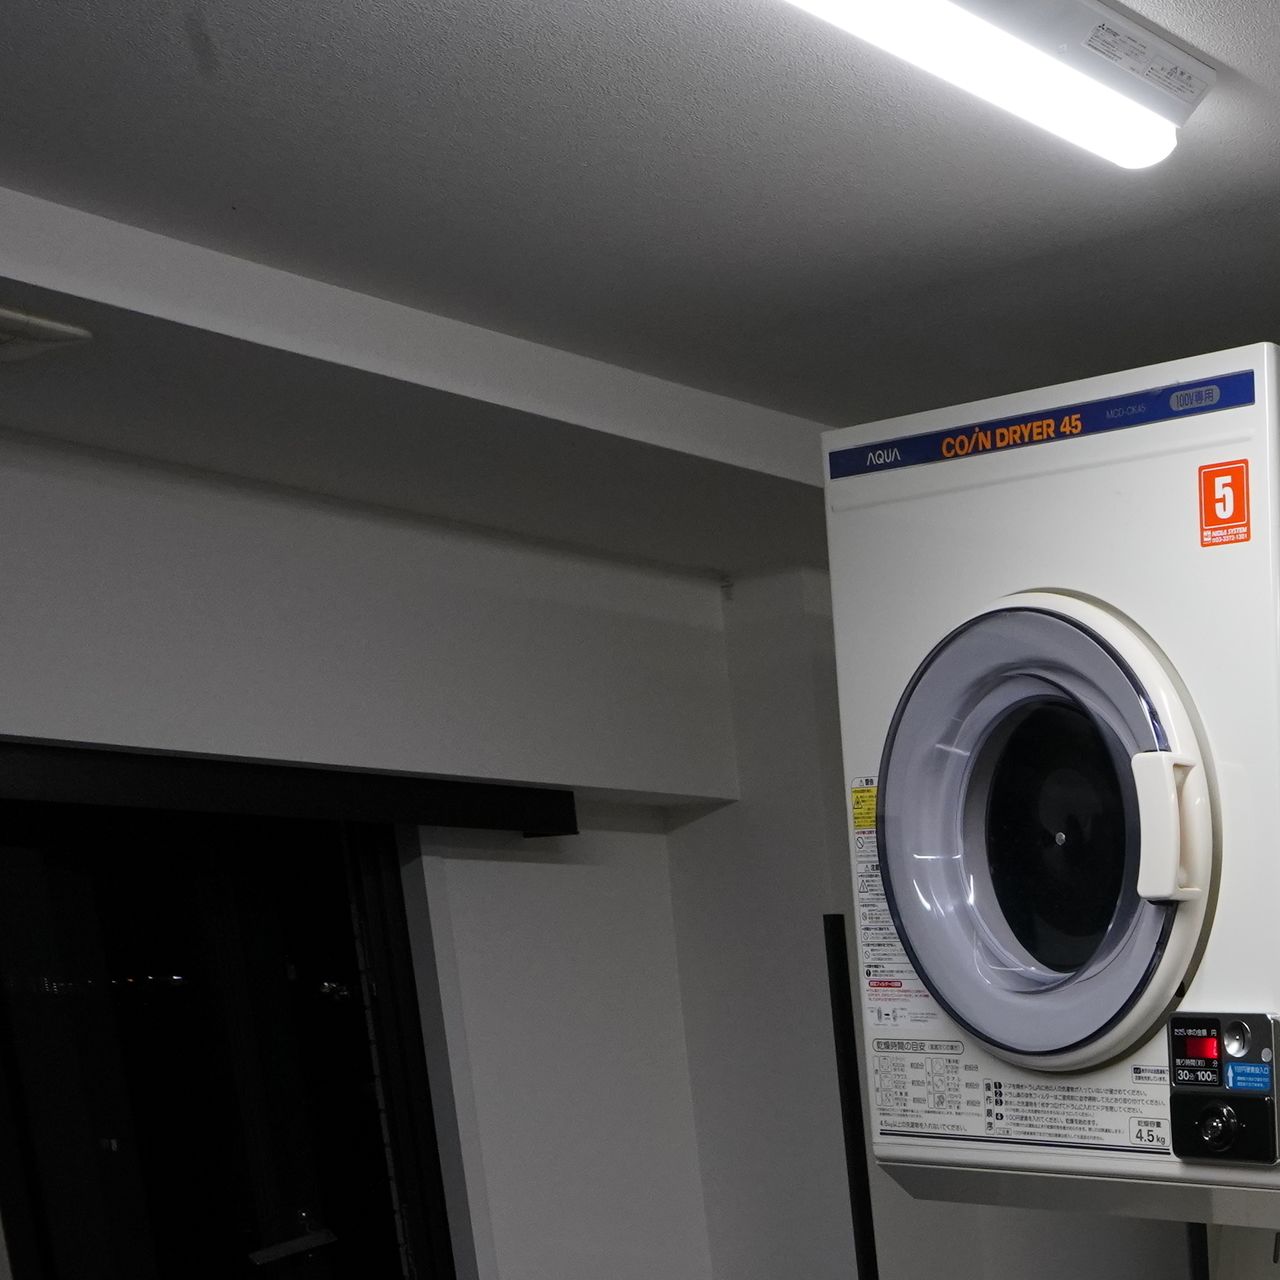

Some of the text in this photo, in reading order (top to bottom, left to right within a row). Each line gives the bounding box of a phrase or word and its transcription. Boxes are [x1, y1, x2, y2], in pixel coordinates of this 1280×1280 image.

[996, 419, 1055, 448] DRYER
[1060, 414, 1082, 434] 45
[867, 448, 901, 466] AQUA
[1215, 475, 1233, 519] 5
